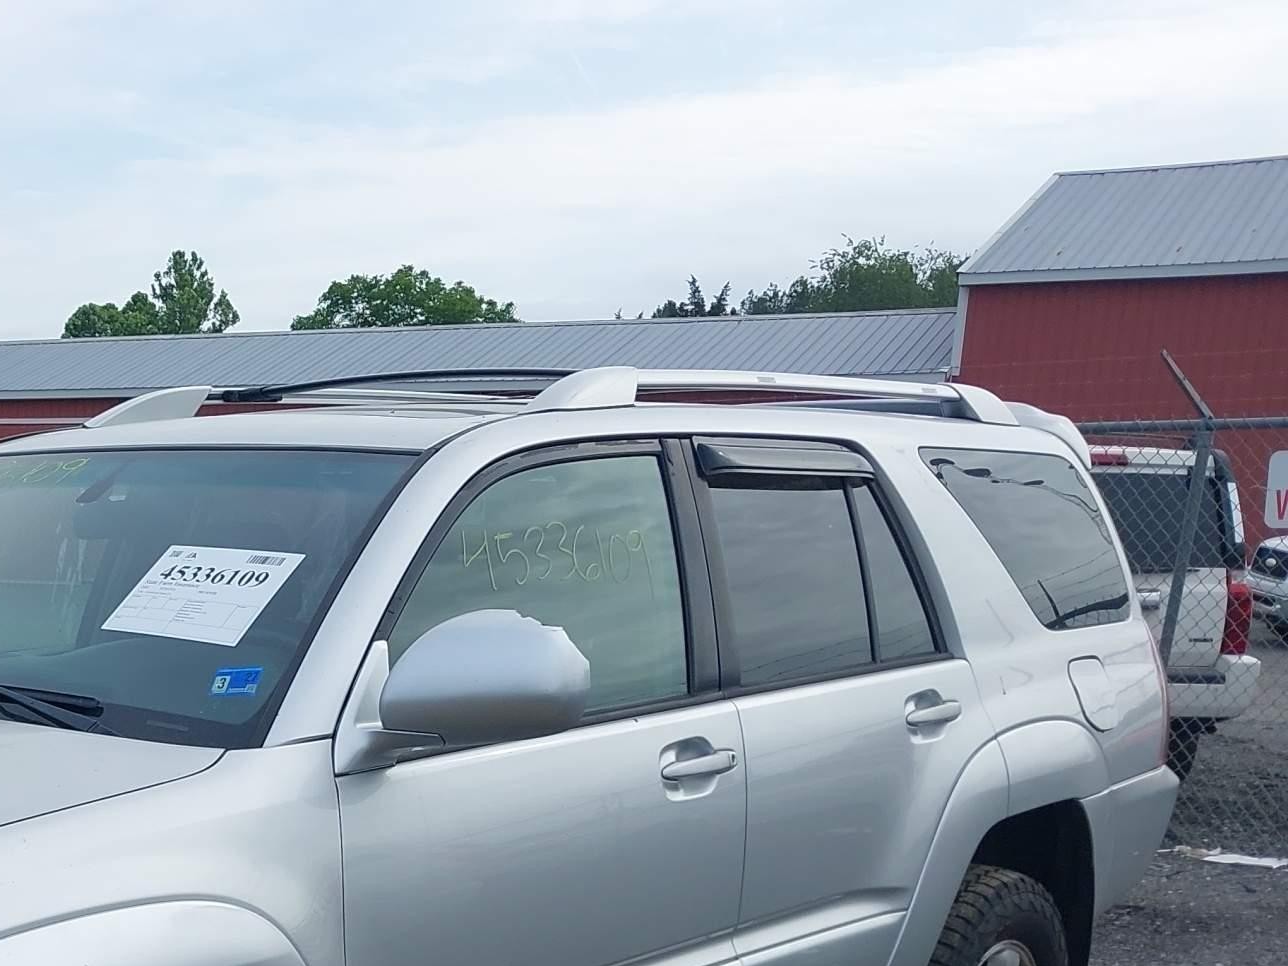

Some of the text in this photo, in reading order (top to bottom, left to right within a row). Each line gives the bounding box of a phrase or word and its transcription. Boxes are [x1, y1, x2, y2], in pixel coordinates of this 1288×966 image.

[461, 521, 655, 600] 45336109
[160, 564, 270, 588] 45336109
[217, 677, 227, 689] 3
